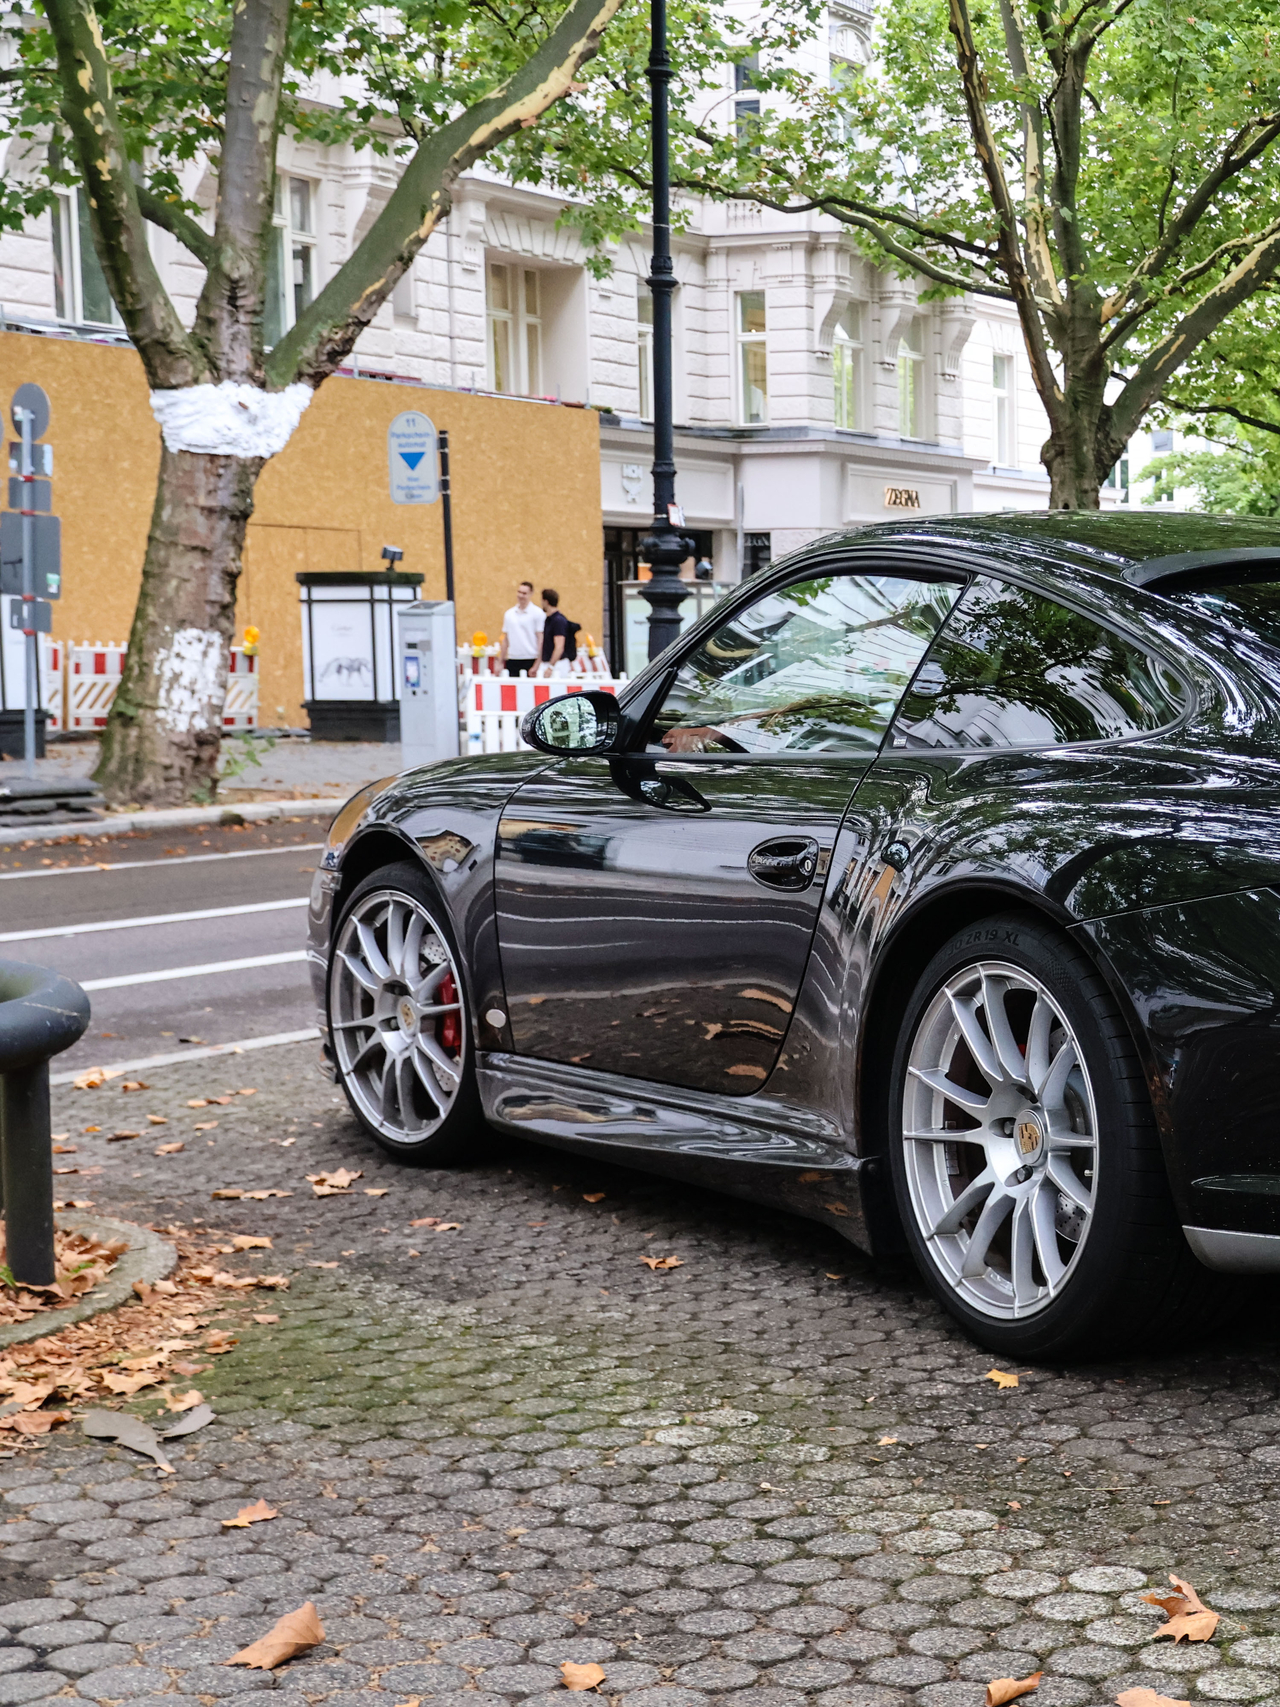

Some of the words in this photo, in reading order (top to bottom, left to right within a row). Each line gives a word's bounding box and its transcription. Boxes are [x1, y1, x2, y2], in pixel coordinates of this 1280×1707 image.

[885, 487, 921, 509] ZEGNA
[965, 931, 982, 946] ZR
[984, 929, 998, 941] 19
[1003, 930, 1020, 946] XL
